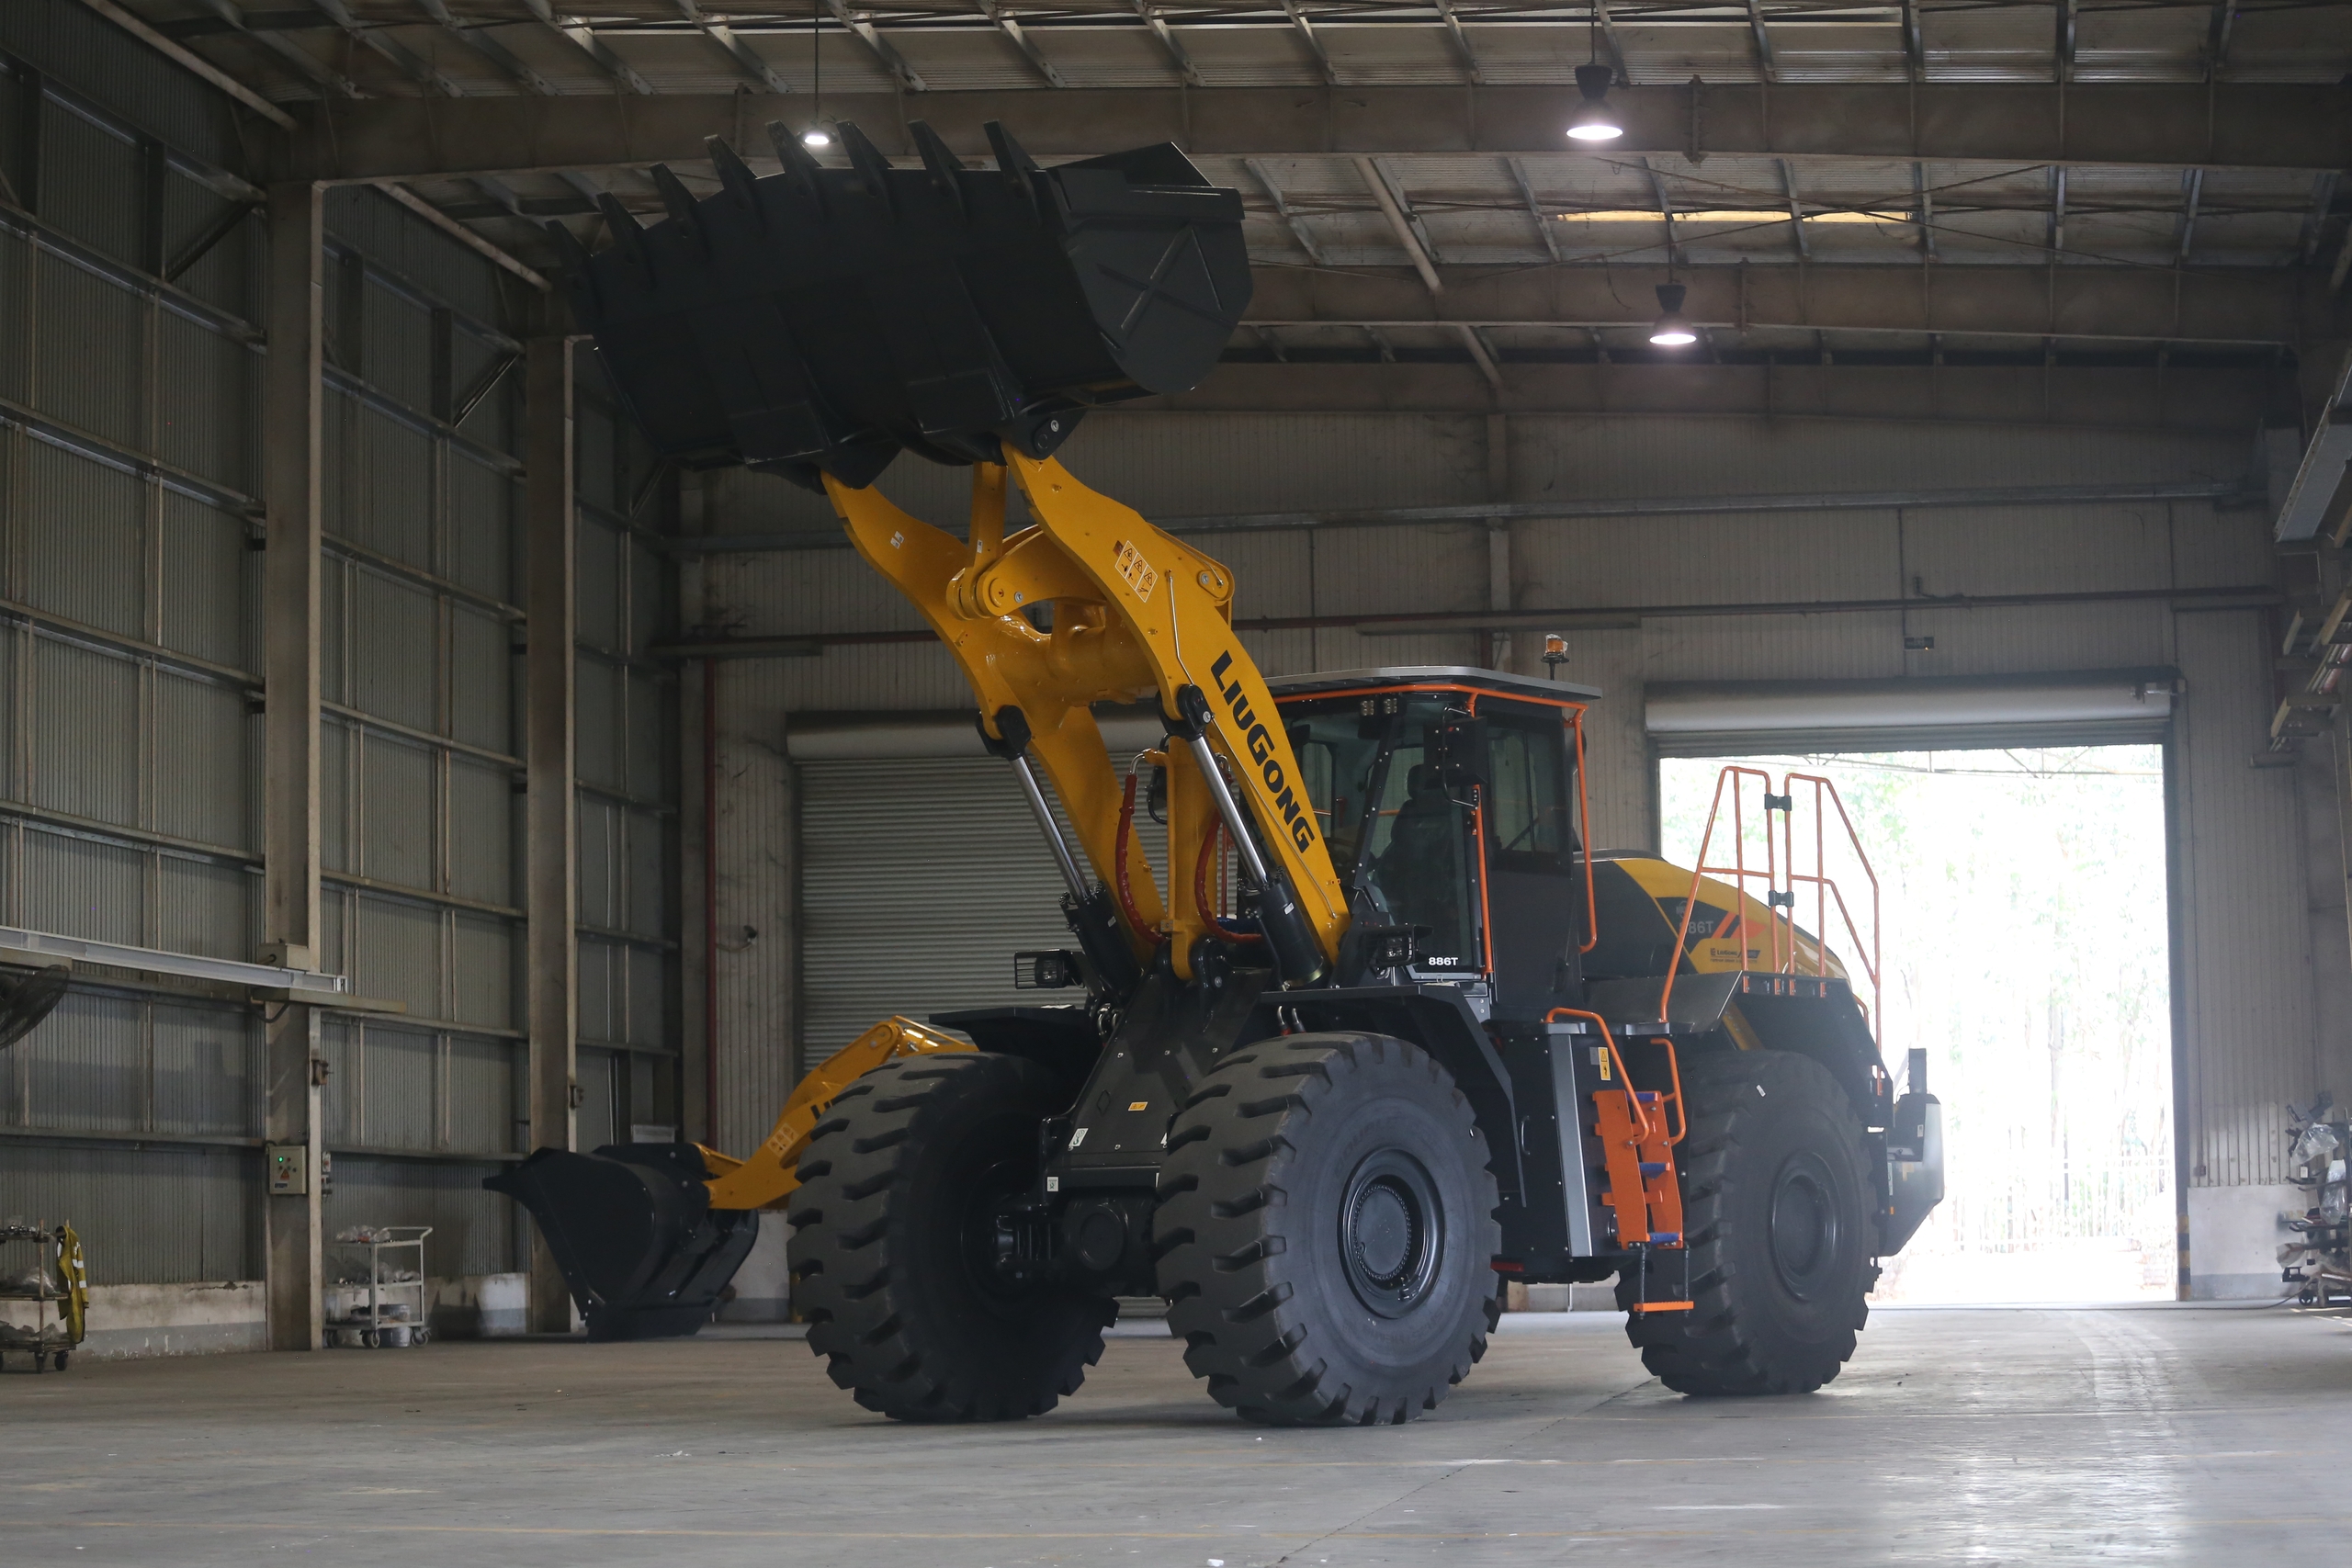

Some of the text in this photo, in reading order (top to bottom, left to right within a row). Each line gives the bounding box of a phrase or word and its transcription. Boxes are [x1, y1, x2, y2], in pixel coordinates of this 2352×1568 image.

[1211, 649, 1315, 853] LIUGONG
[1679, 920, 1713, 934] 86T
[1429, 957, 1458, 966] 886T
